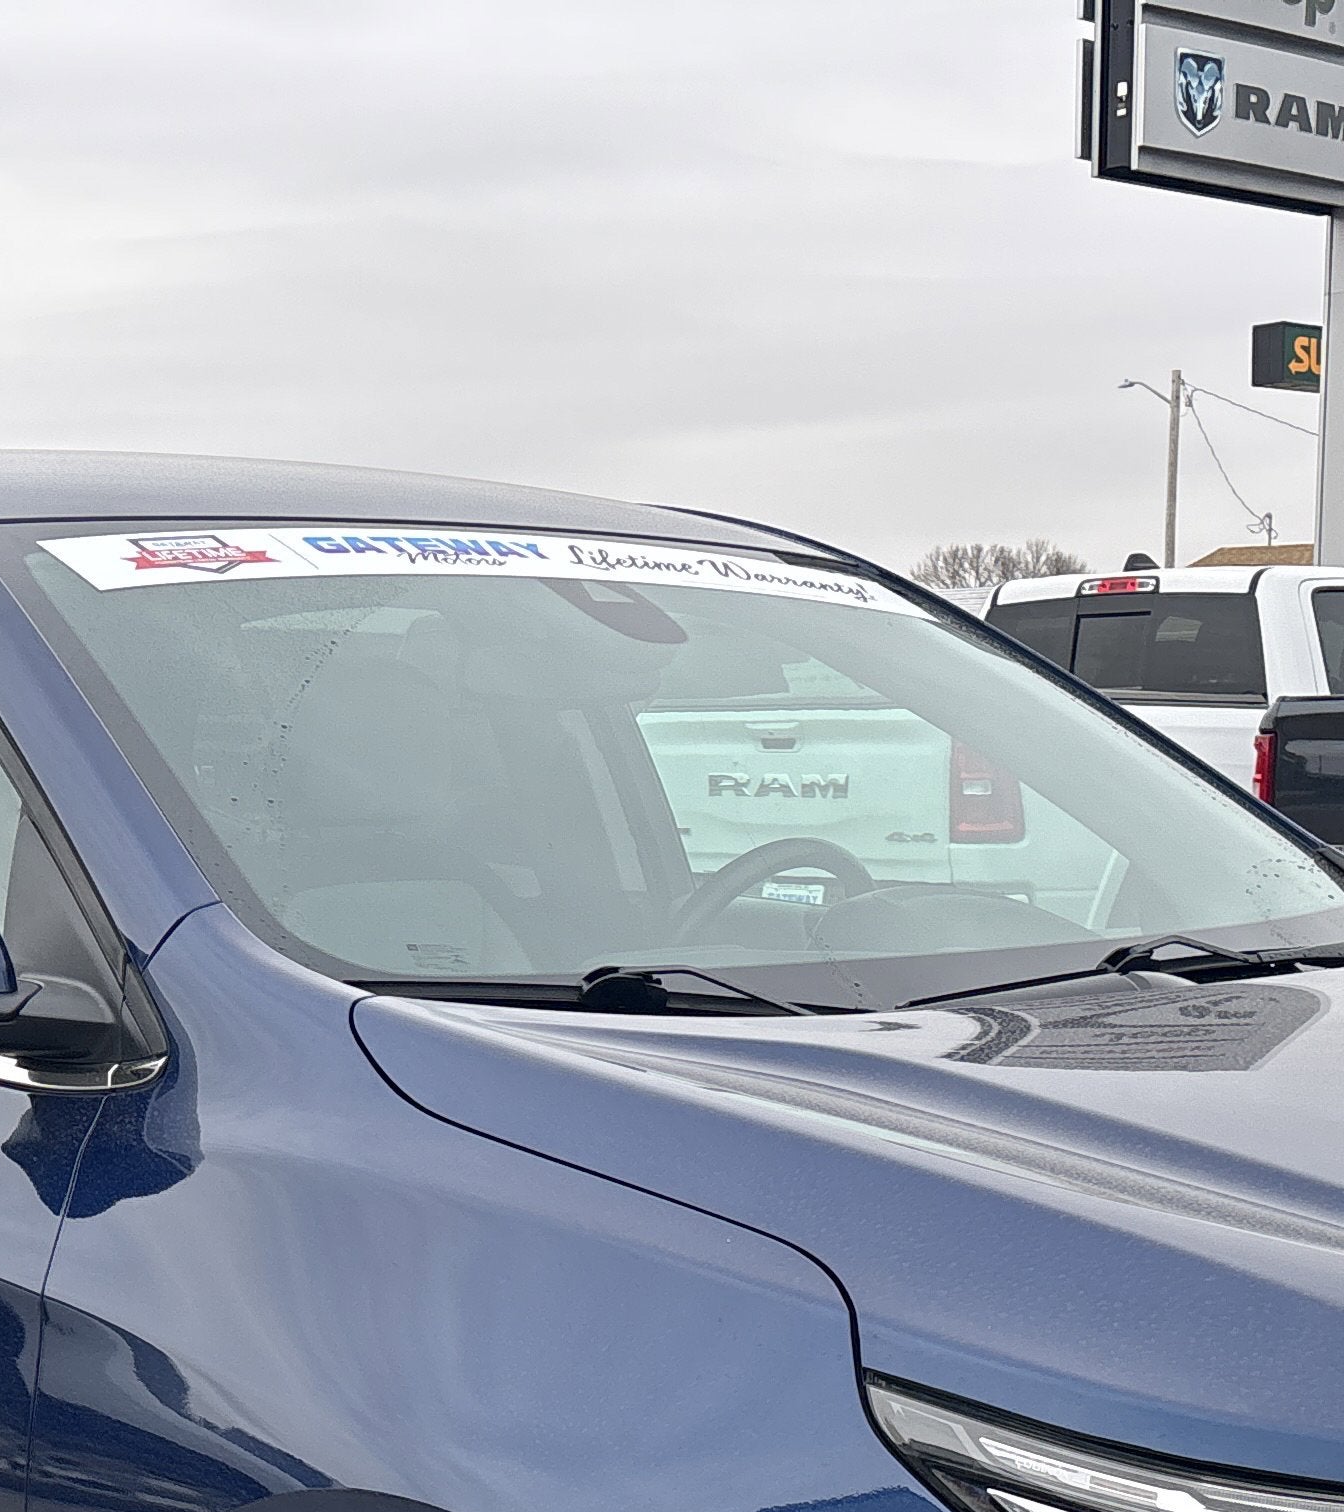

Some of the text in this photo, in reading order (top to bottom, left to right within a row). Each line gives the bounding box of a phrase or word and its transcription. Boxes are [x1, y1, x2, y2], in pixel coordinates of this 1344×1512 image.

[141, 547, 247, 561] LIFETIME
[302, 536, 550, 560] GATEWAY
[568, 544, 700, 576] Lifetime
[397, 551, 508, 567] Motors
[707, 771, 850, 800] RAM
